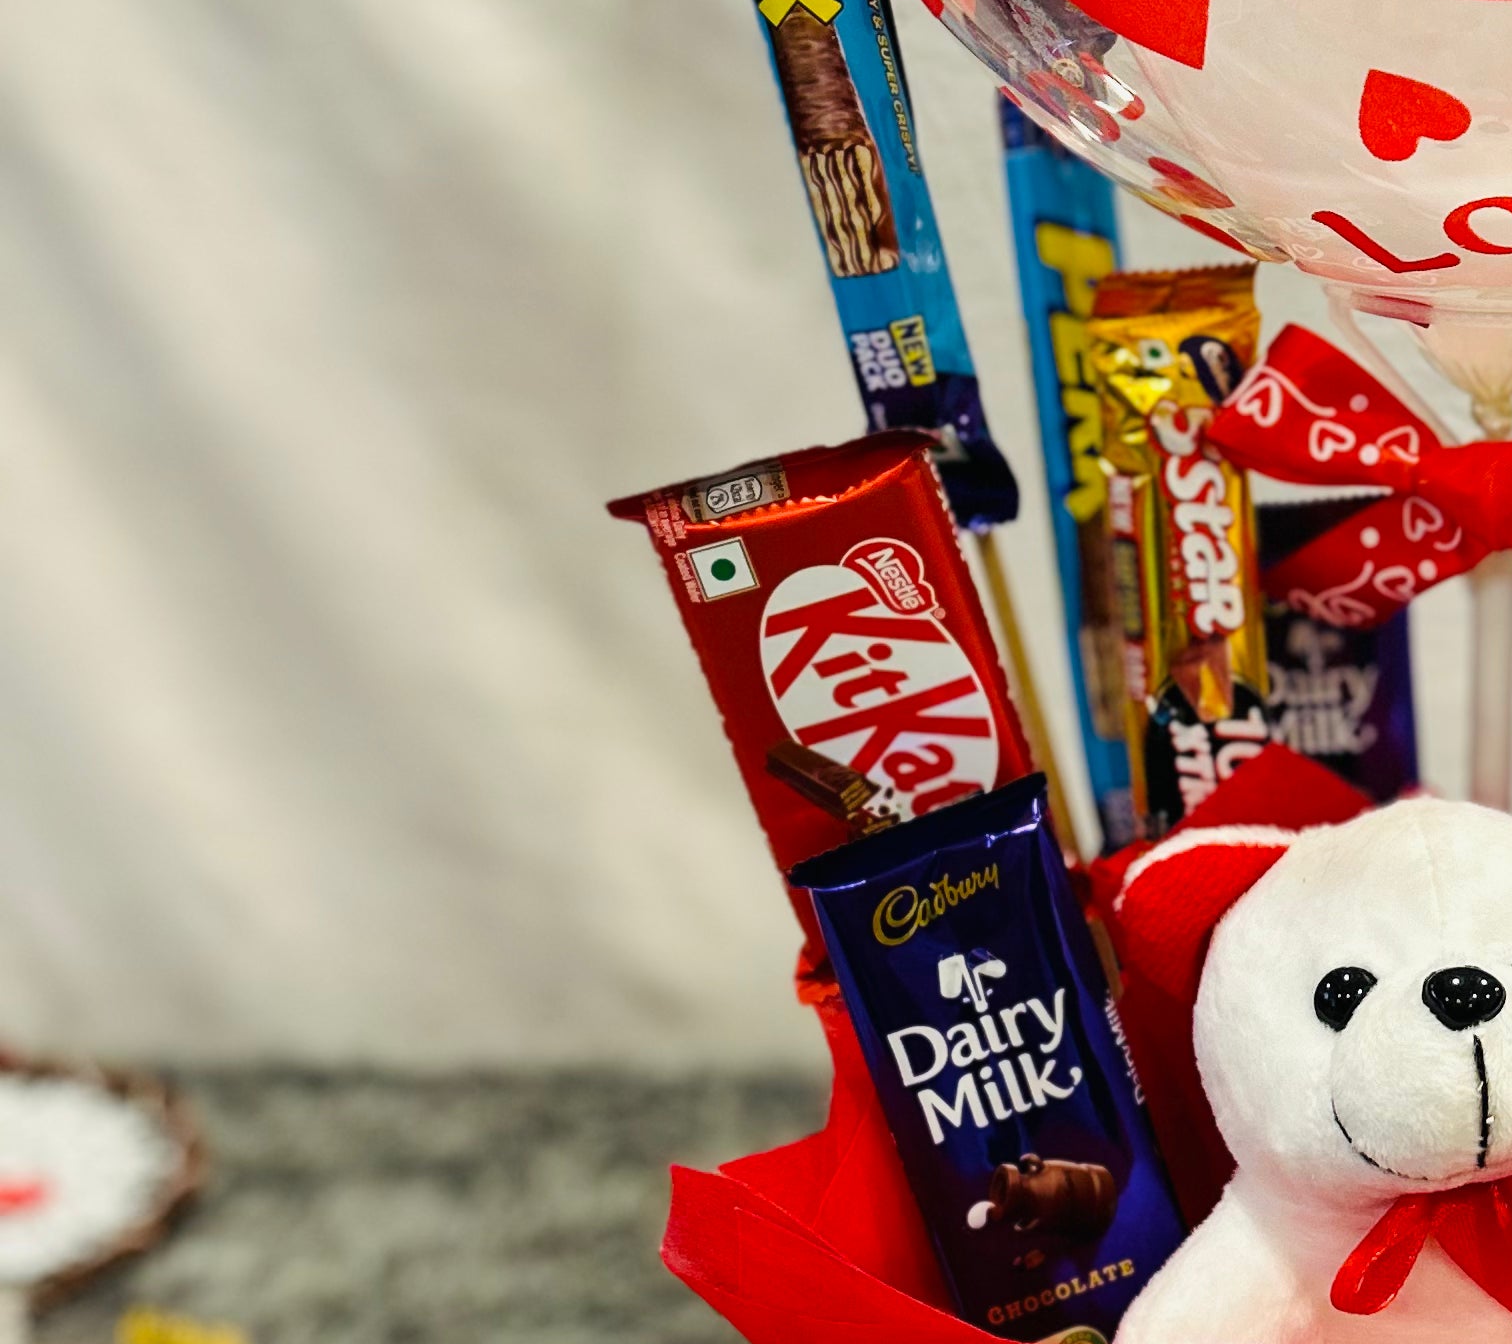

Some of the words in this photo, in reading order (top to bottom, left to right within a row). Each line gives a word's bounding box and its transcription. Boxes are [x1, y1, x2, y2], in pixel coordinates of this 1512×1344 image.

[876, 33, 899, 99] SUPER
[850, 332, 888, 392] PACK
[869, 330, 906, 387] DUO
[895, 319, 931, 380] NEW
[872, 861, 1001, 947] Cadbury
[886, 987, 1068, 1088] Dairy
[986, 1257, 1137, 1327] CHOCOLATE
